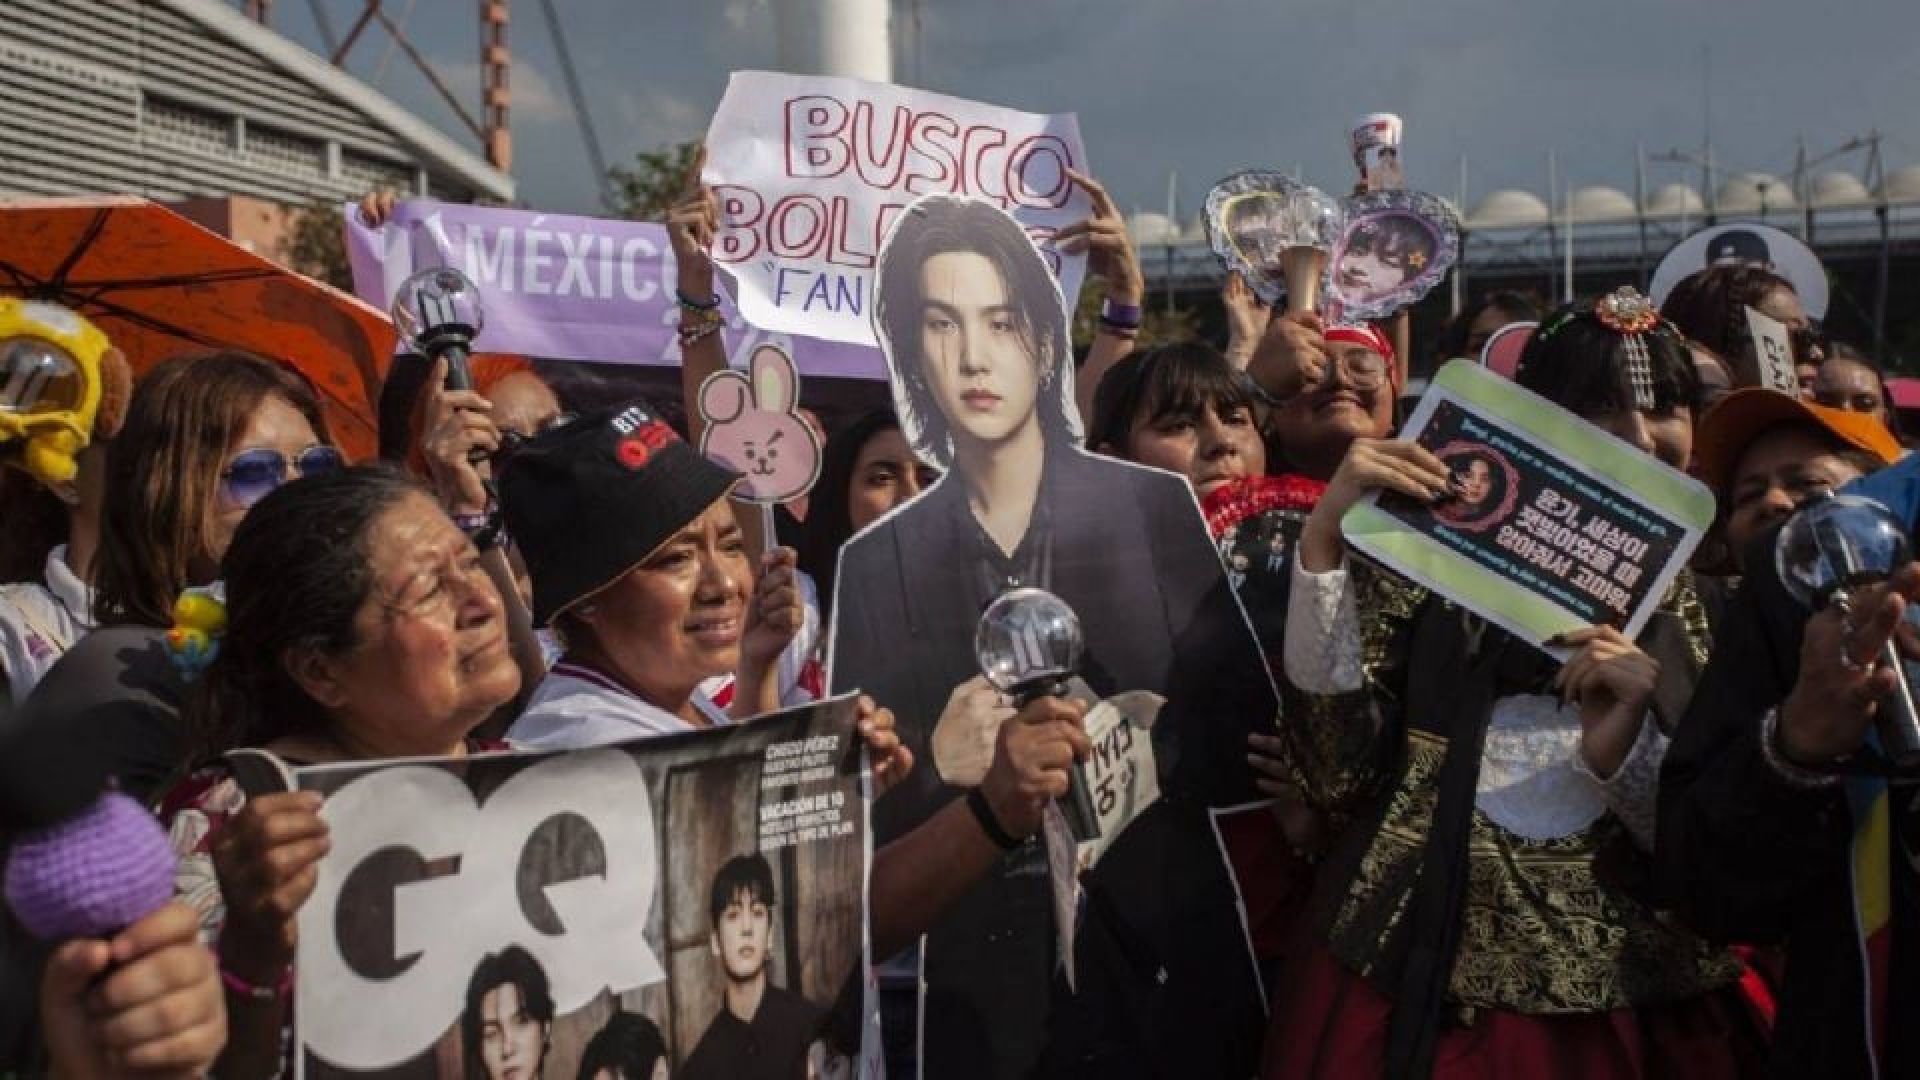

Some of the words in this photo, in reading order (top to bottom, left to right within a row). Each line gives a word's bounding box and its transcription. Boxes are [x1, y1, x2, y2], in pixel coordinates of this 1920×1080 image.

[784, 95, 1073, 210] BUSCO
[1582, 516, 1648, 563] 세상이
[297, 747, 667, 1070] GQ
